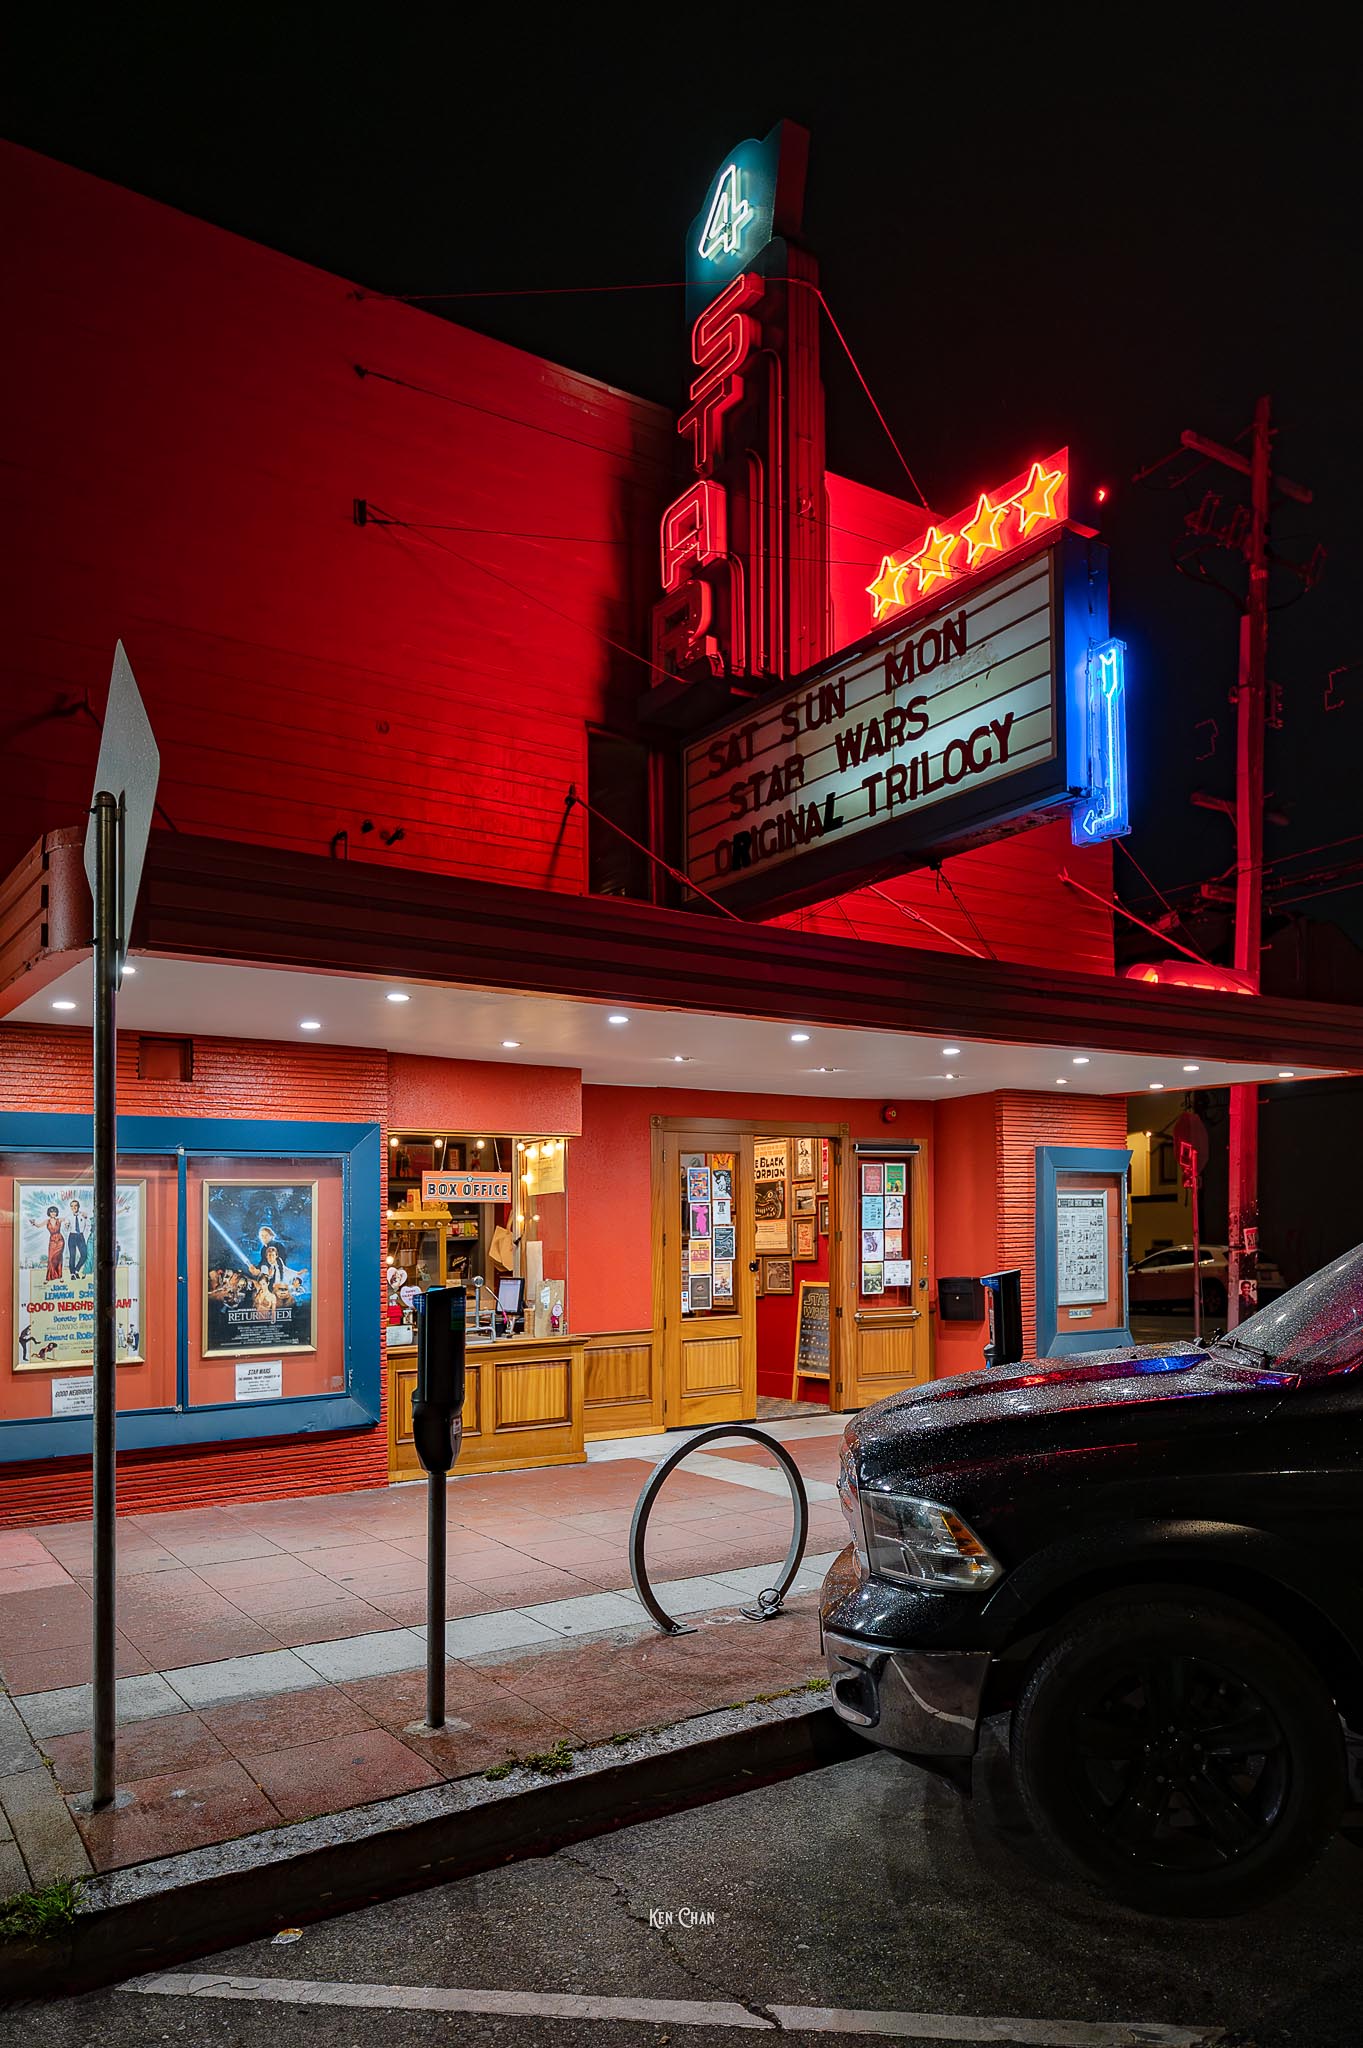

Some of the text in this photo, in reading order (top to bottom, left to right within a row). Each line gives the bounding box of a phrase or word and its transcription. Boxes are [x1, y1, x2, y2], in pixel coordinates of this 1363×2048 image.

[697, 163, 752, 261] 4
[651, 273, 763, 690] STAR
[707, 609, 968, 779] SAT SUN MON
[714, 712, 1015, 877] ORIGINAL TRILOGY
[729, 696, 930, 821] STAR WARS
[427, 1183, 508, 1196] BOX OFFICE
[760, 1156, 784, 1168] BLACK
[57, 1301, 94, 1312] NEIGHB
[228, 1312, 265, 1321] RETURN
